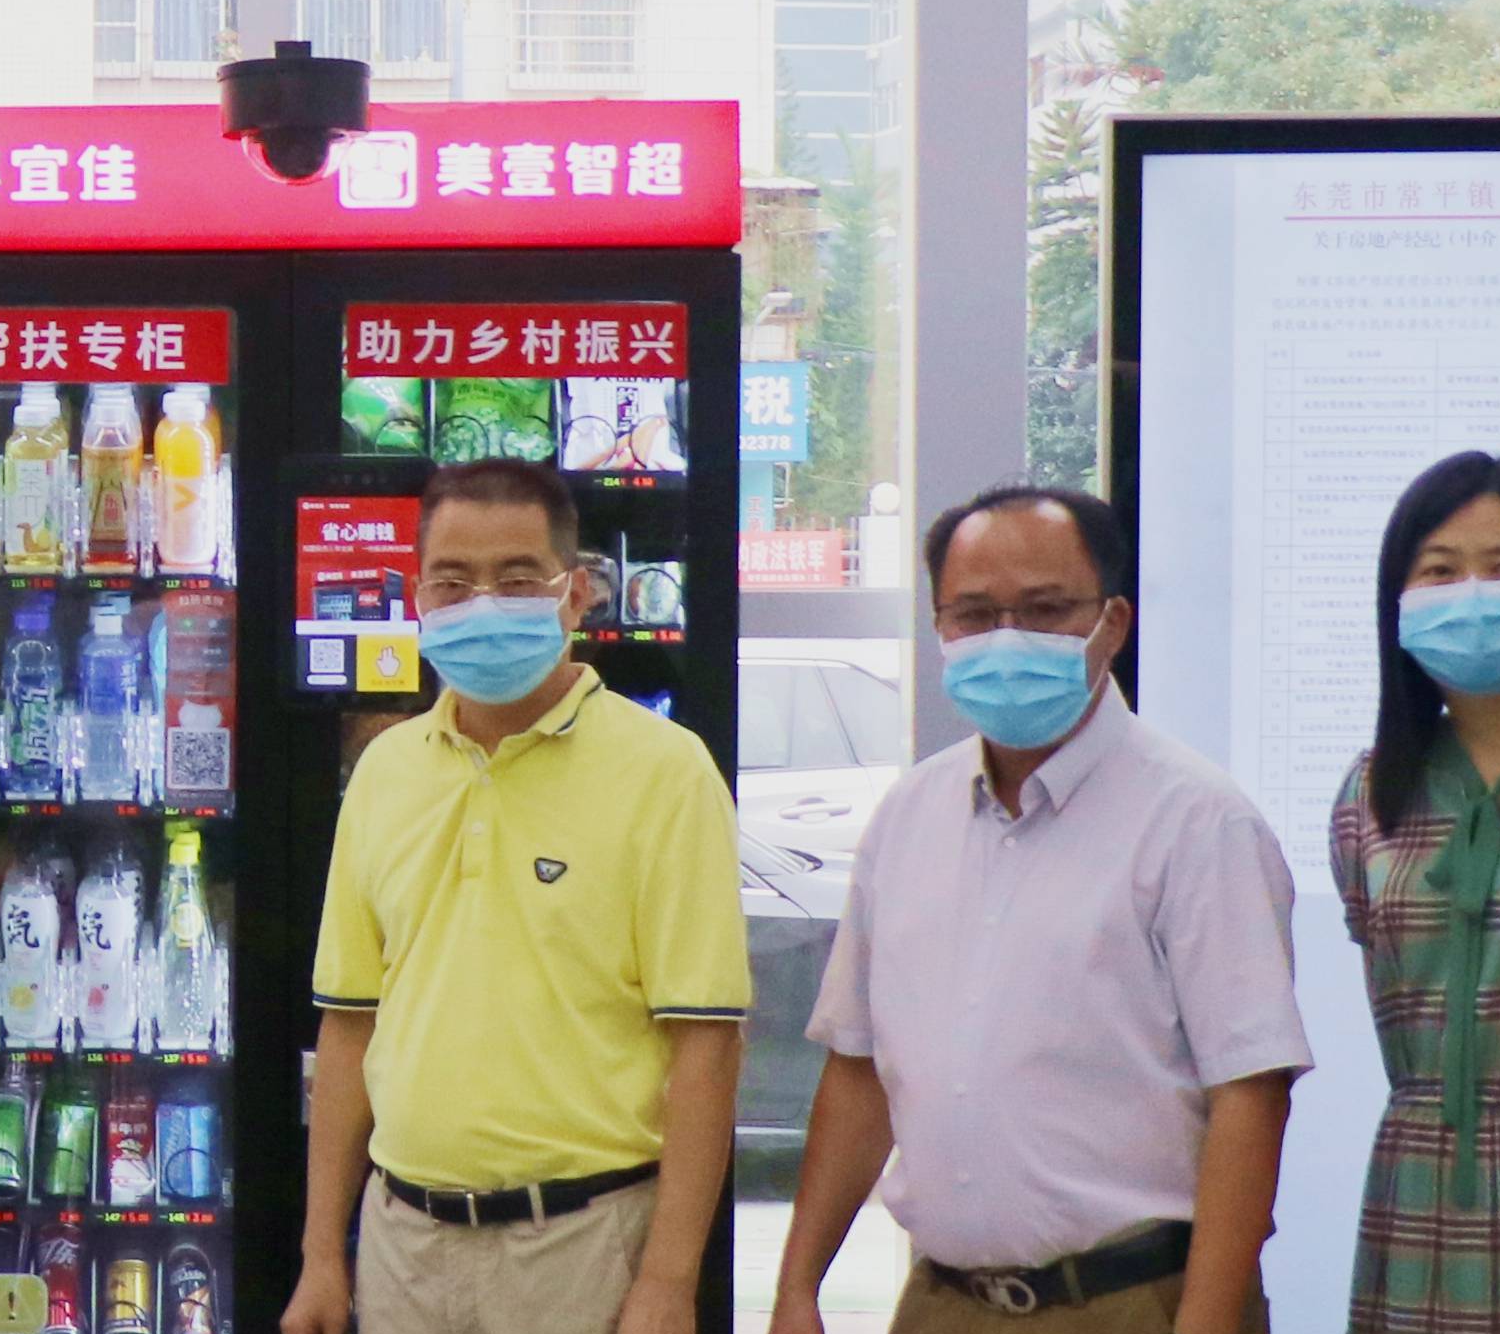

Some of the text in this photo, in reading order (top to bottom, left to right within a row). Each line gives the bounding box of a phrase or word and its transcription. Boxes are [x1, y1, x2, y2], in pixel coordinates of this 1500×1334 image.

[436, 141, 685, 199] 美壹智超
[356, 317, 677, 367] 助力乡村振兴
[743, 375, 794, 426] 税
